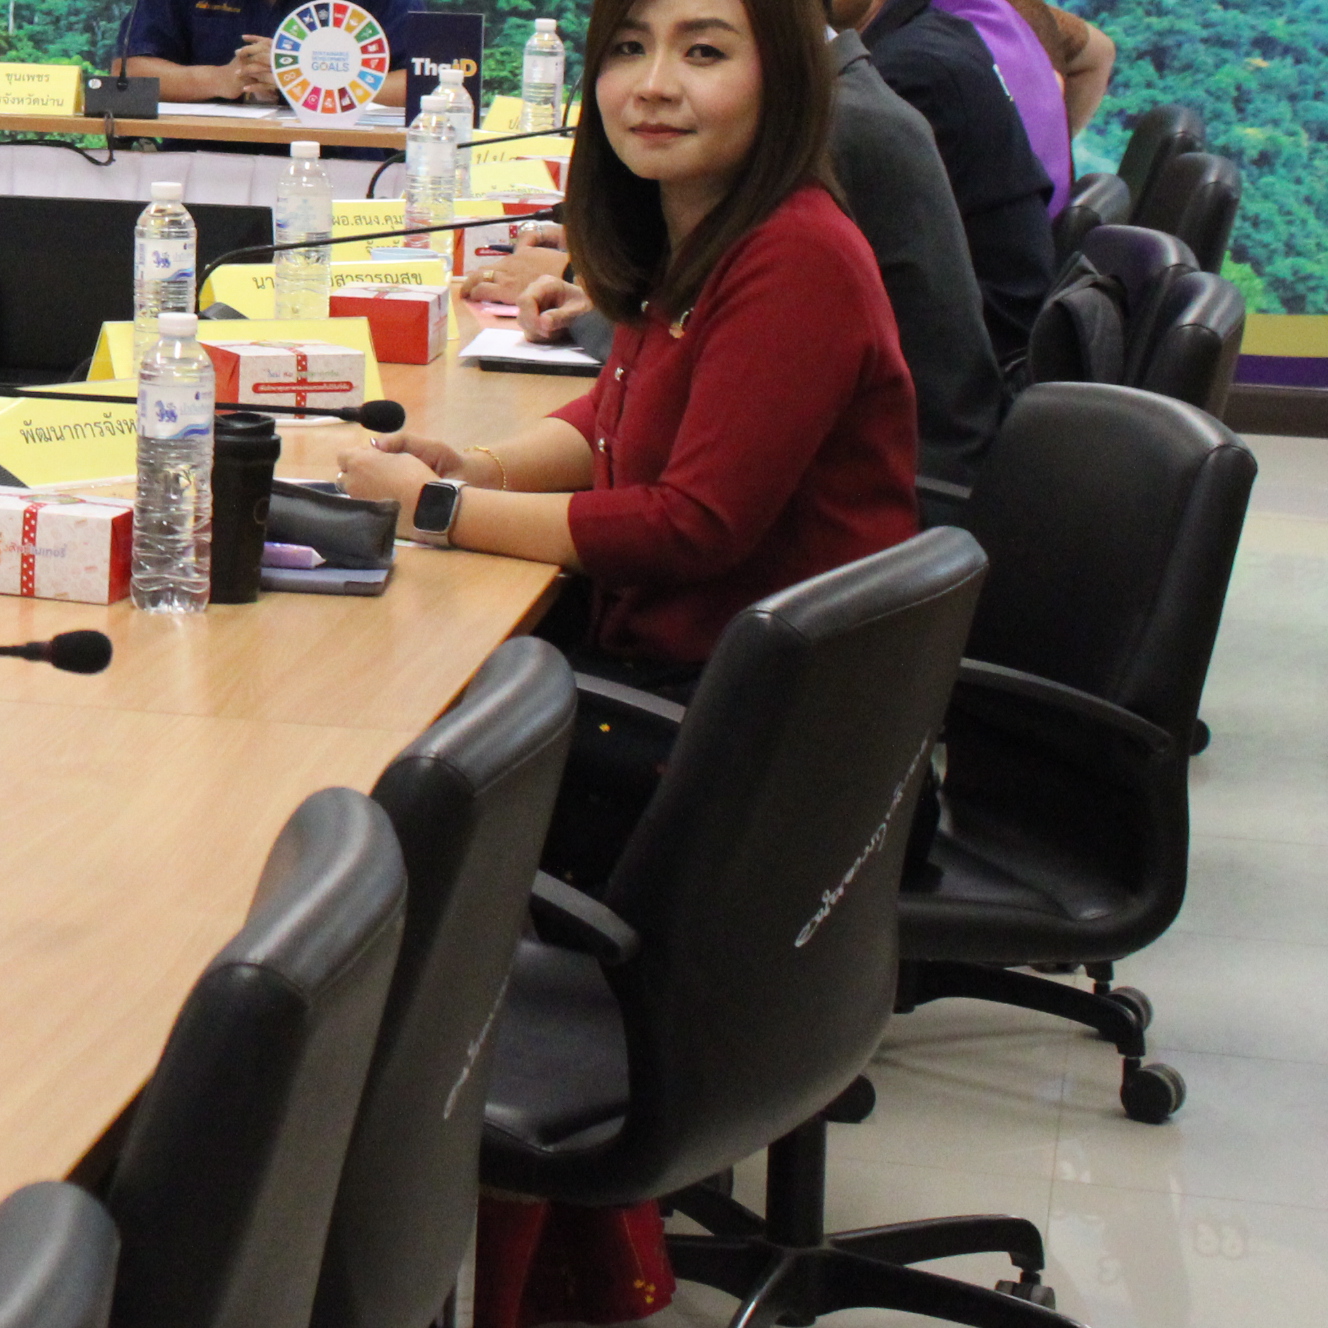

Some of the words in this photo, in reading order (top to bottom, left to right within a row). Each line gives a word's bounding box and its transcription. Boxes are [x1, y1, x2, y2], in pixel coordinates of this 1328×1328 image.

[311, 61, 350, 72] GOALS
[19, 410, 137, 445] พัฒนาการจังห
